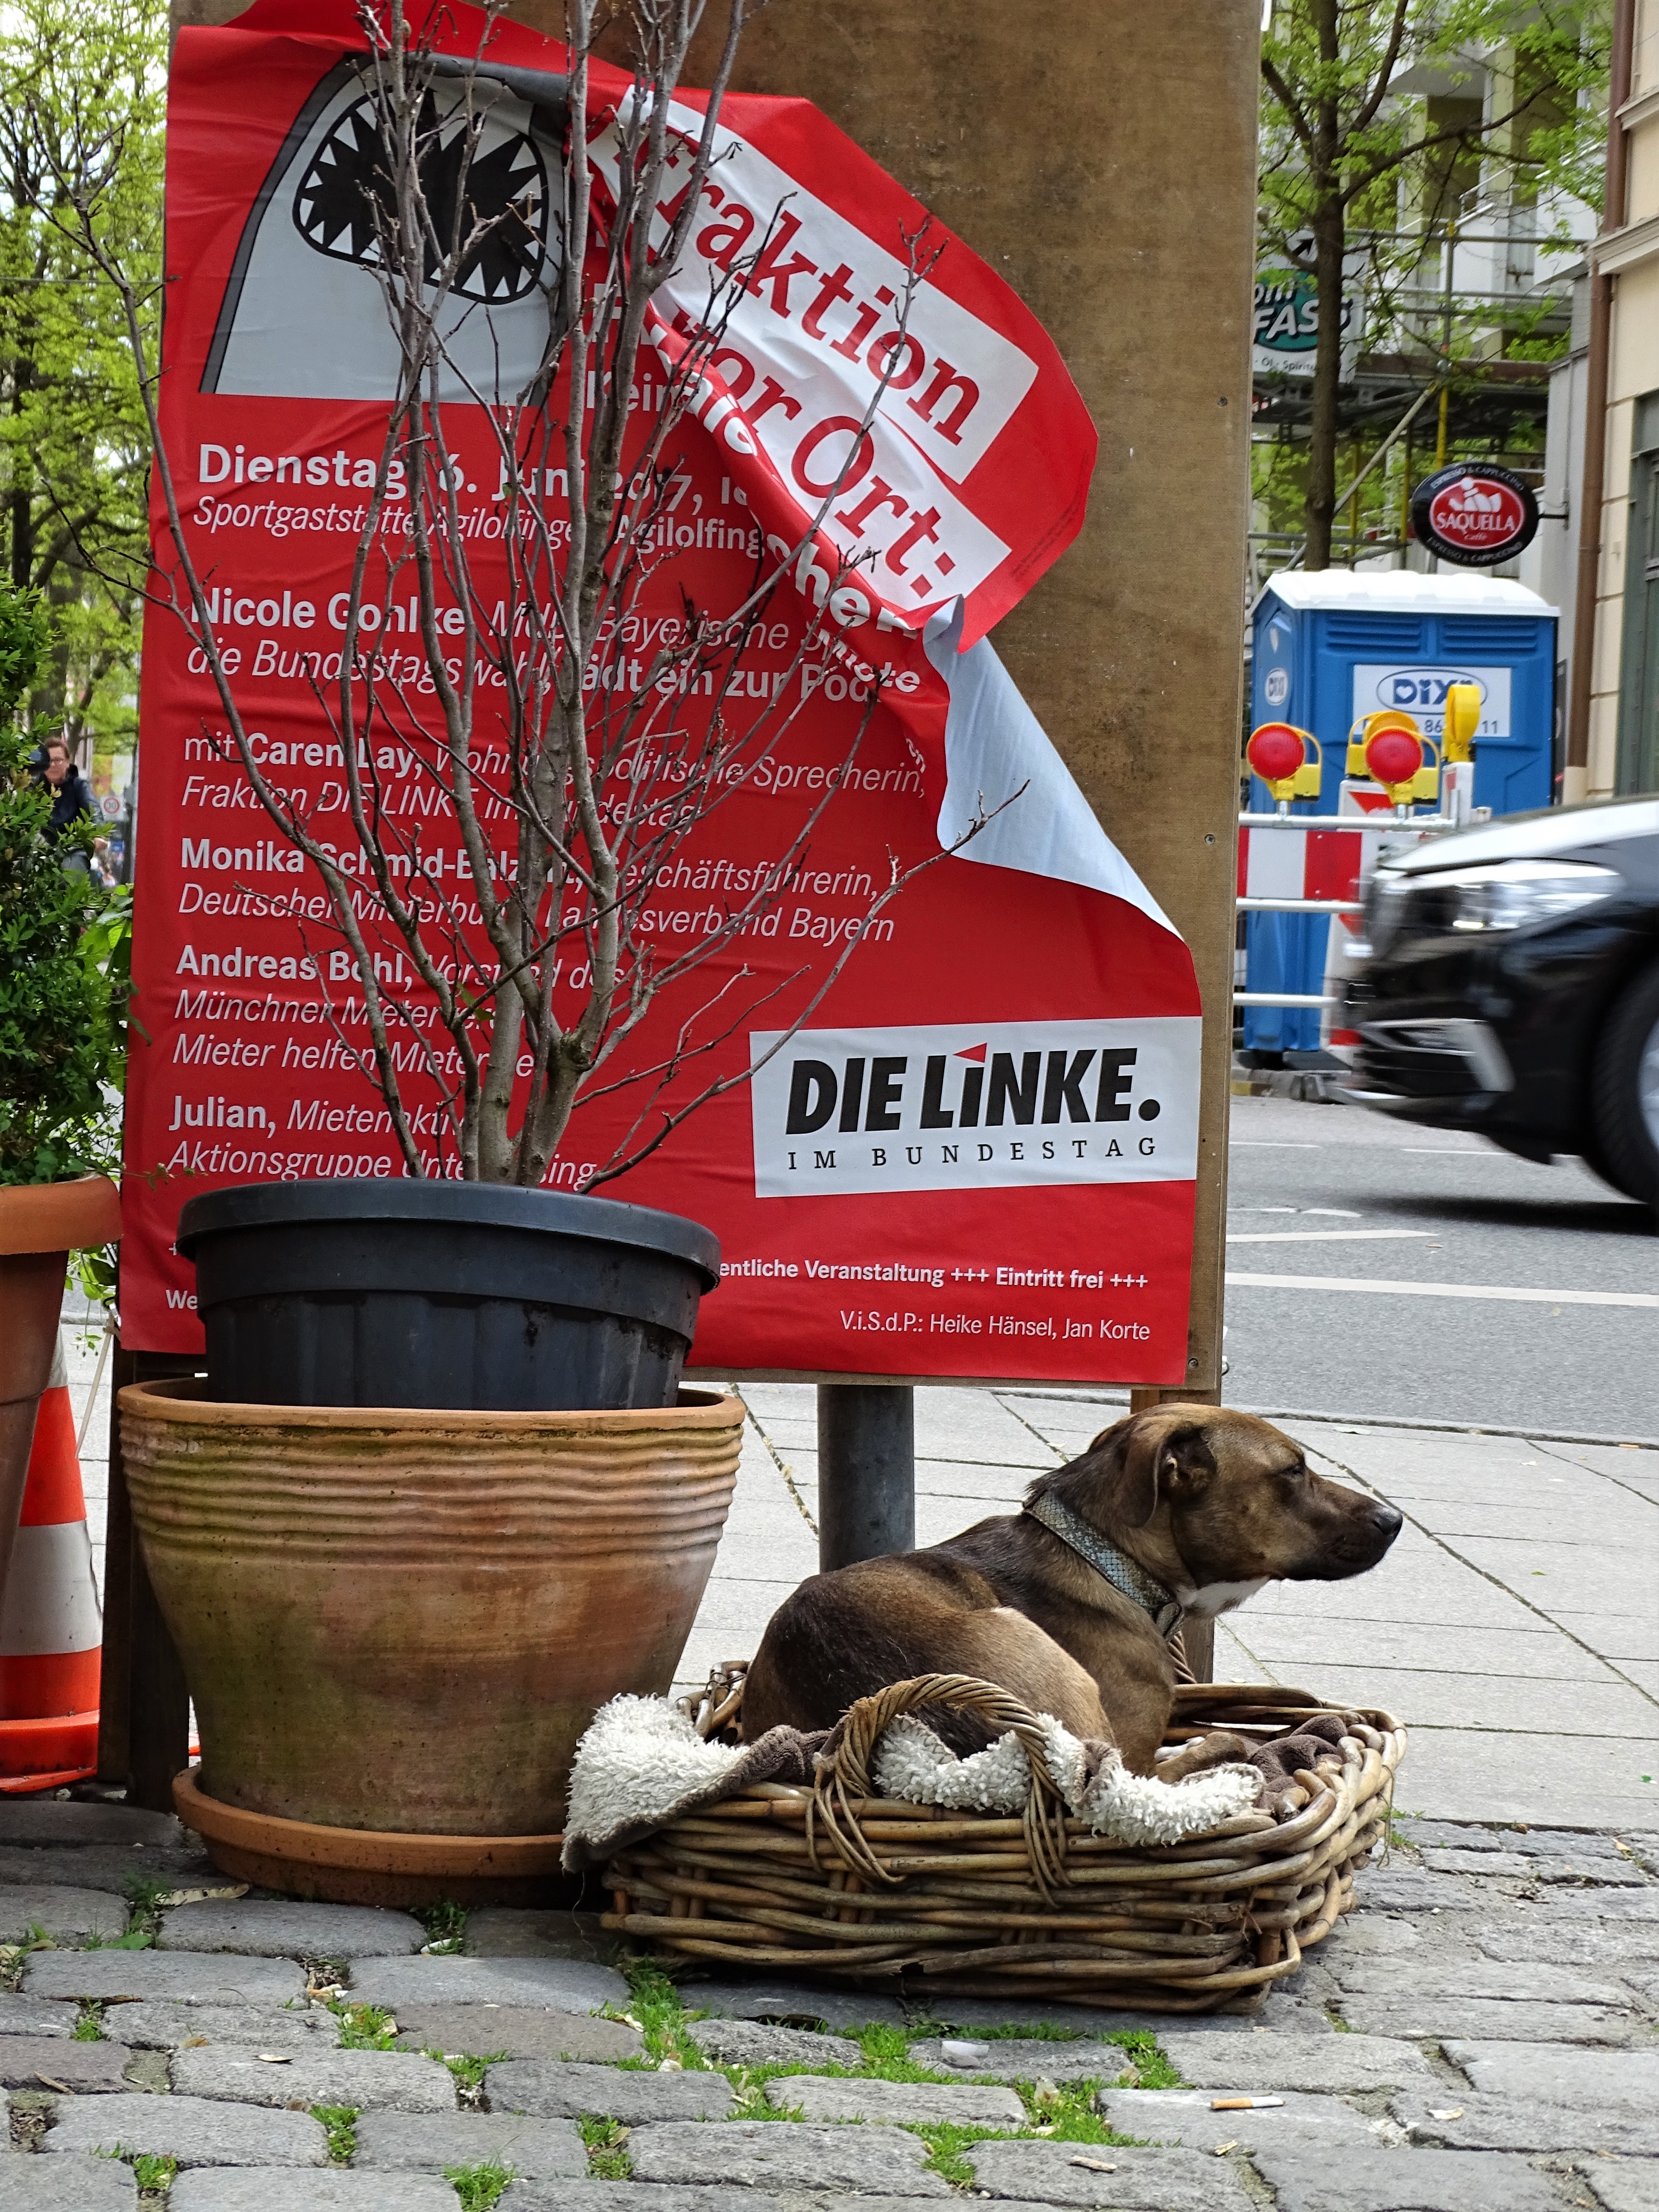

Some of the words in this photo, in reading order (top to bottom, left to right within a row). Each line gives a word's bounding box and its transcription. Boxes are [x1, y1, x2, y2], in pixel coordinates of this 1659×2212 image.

[1254, 298, 1348, 340] FAS
[614, 472, 702, 515] 07,
[791, 415, 956, 599] Ort:
[1436, 512, 1515, 535] SAQUELLA
[191, 587, 315, 629] Nicole
[581, 653, 643, 693] ädt
[655, 659, 713, 696] ein
[185, 731, 235, 762] mit
[246, 732, 343, 766] Caren
[357, 737, 422, 780] Lay,
[754, 756, 925, 799] Sprecherin,
[381, 784, 479, 818] LINK
[181, 838, 304, 873] Monika
[615, 857, 877, 902] eschäftsführerin,
[178, 882, 338, 918] Deutscher
[789, 908, 894, 947] Bayern
[175, 944, 317, 981] Andreas
[174, 989, 336, 1024] Münchner
[172, 1033, 276, 1067] Mieter
[282, 1037, 376, 1071] helfen
[786, 1056, 908, 1135] DIE
[169, 1095, 276, 1139] Julian,
[166, 1140, 392, 1182] Aktionsgruppe
[788, 1150, 837, 1170] IM
[872, 1137, 1156, 1167] BUNDESTAG
[804, 1260, 945, 1287] Veranstaltung
[996, 1267, 1065, 1288] Eintritt
[1069, 1269, 1104, 1289] frei
[930, 1314, 982, 1334] Heike
[989, 1316, 1057, 1339] Hänsel,
[1062, 1318, 1094, 1338] Jan
[1100, 1319, 1150, 1340] Korte
